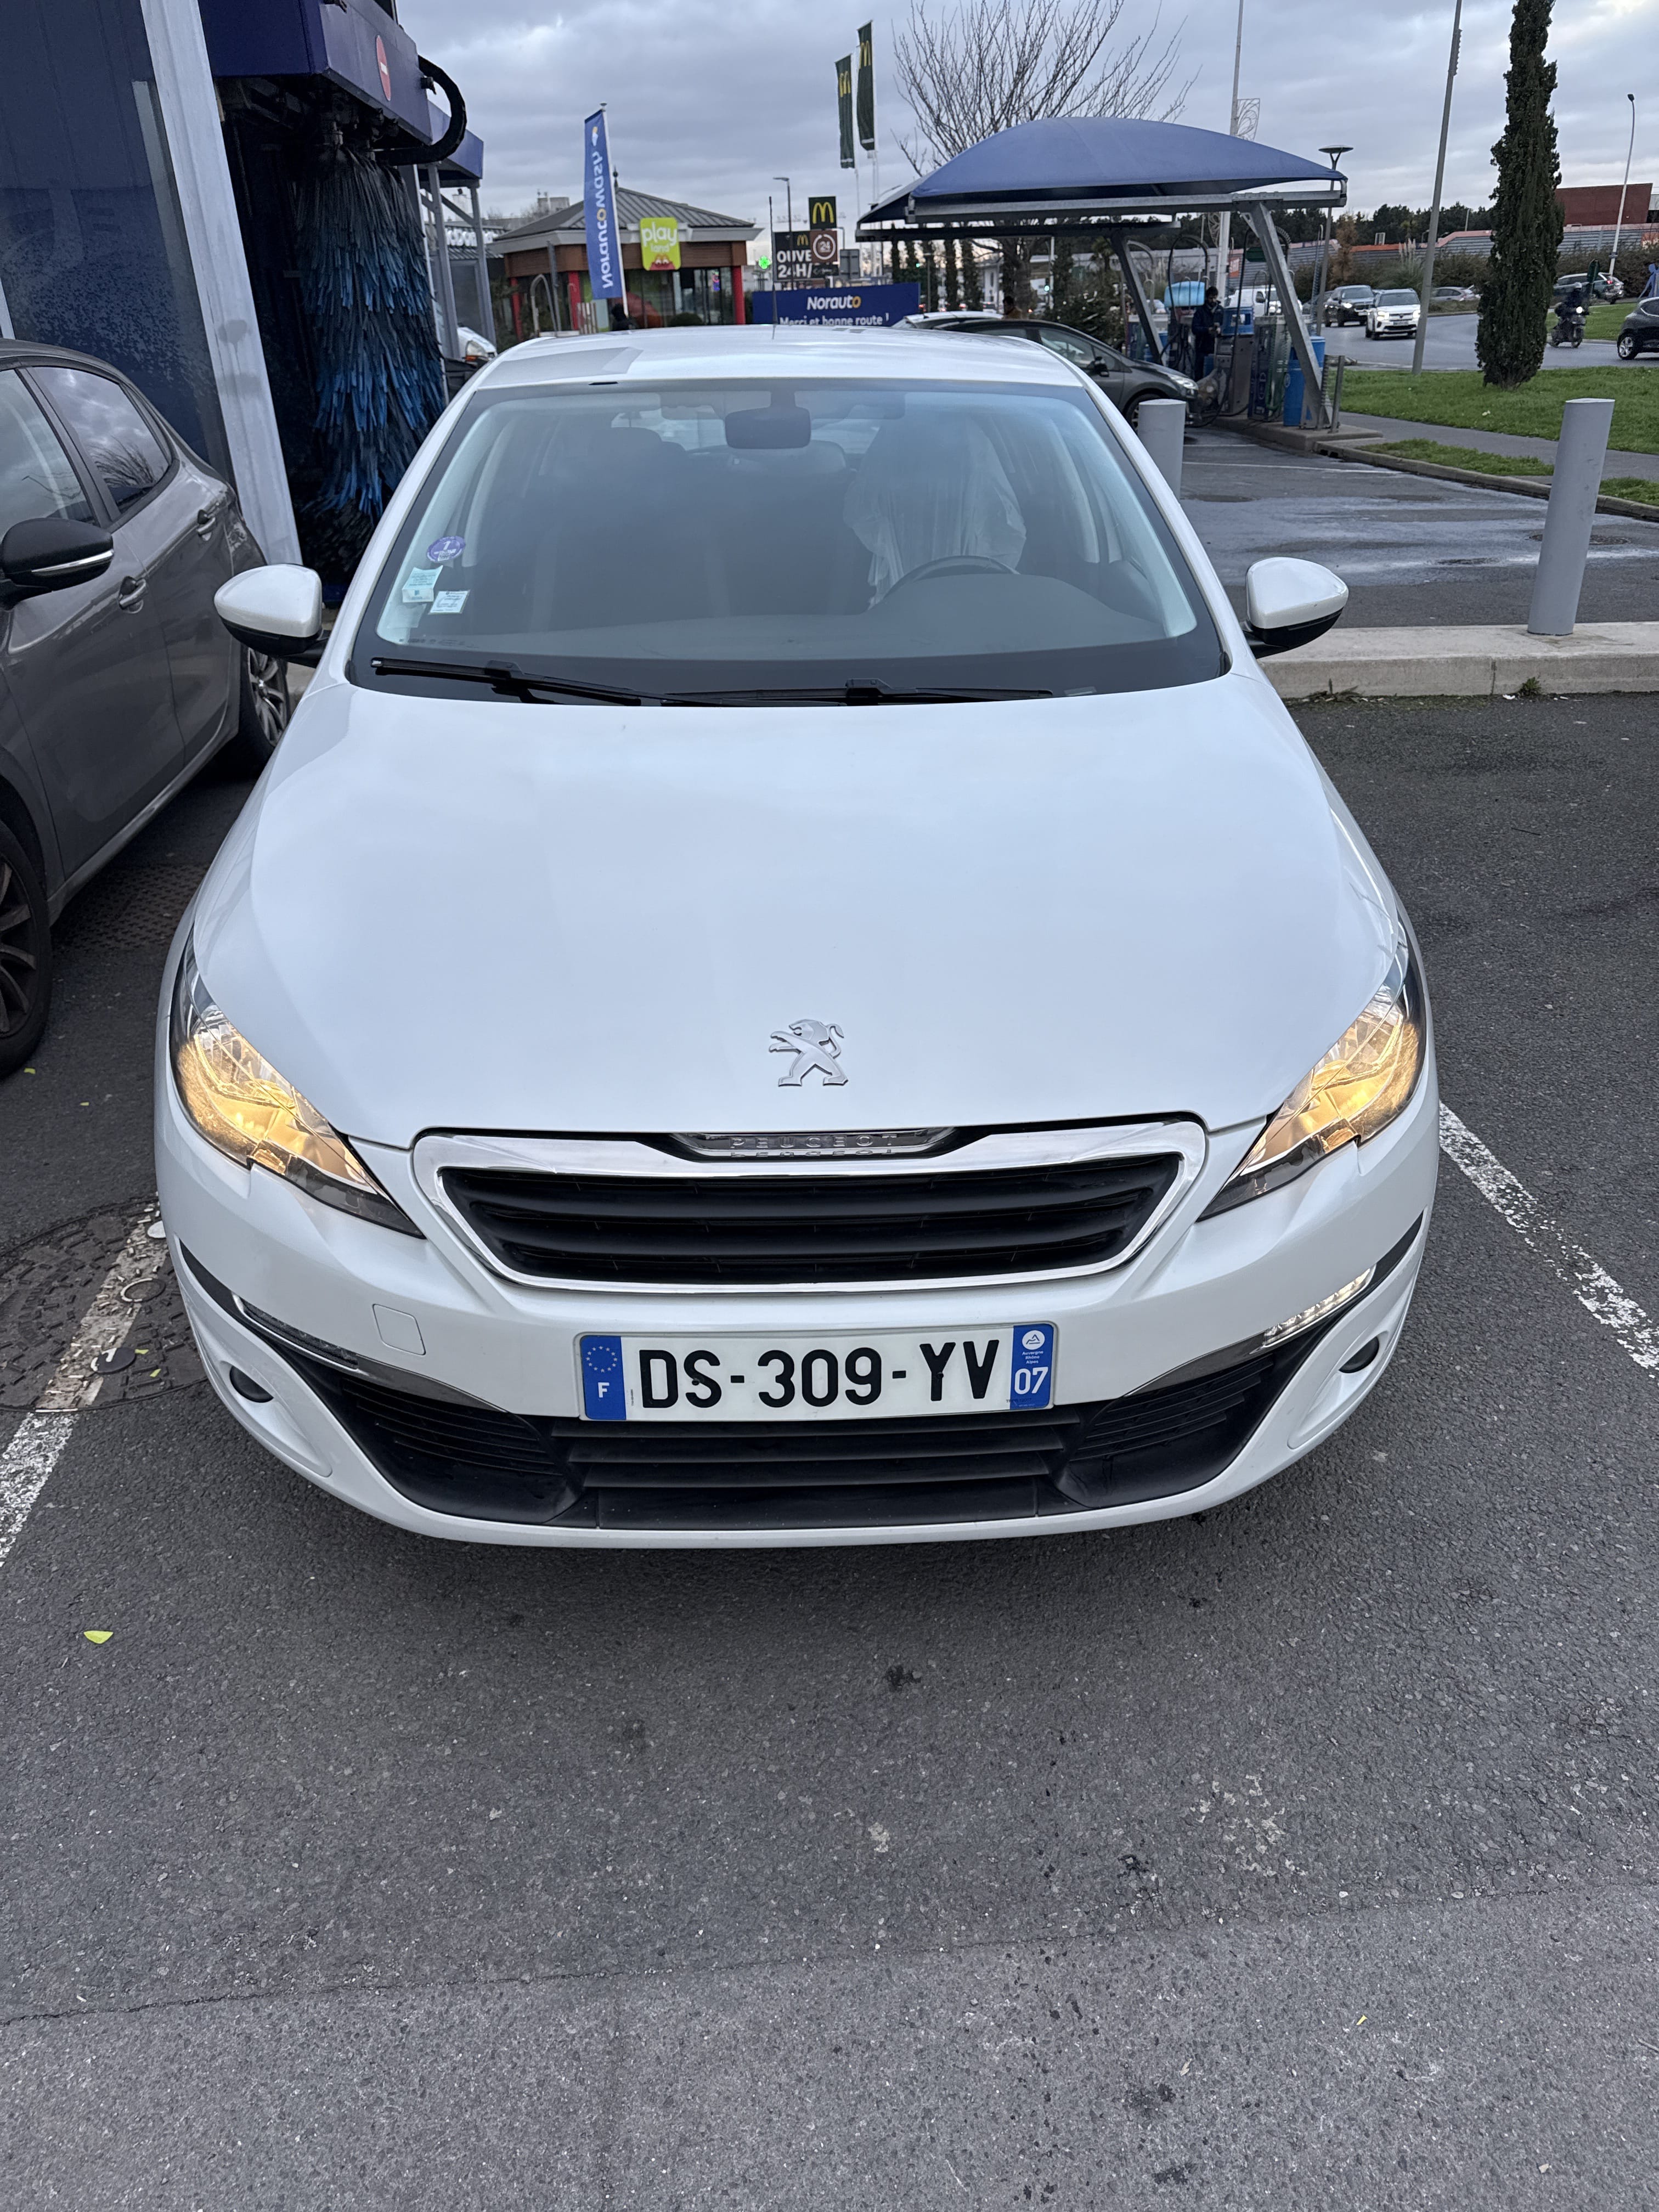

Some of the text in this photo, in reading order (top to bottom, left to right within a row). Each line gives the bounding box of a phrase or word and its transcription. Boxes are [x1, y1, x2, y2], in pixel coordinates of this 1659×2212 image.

[812, 201, 834, 224] M
[642, 222, 678, 246] play
[651, 243, 669, 252] land
[777, 250, 812, 263] OUVE
[806, 295, 861, 310] Norauto
[809, 317, 820, 325] et
[822, 315, 854, 325] bonne
[855, 315, 883, 325] route
[443, 541, 451, 550] 1
[730, 1134, 897, 1148] PEUGEOT
[639, 1340, 1000, 1408] DS-309-YV
[1014, 1367, 1048, 1395] 07
[597, 1382, 610, 1398] F
